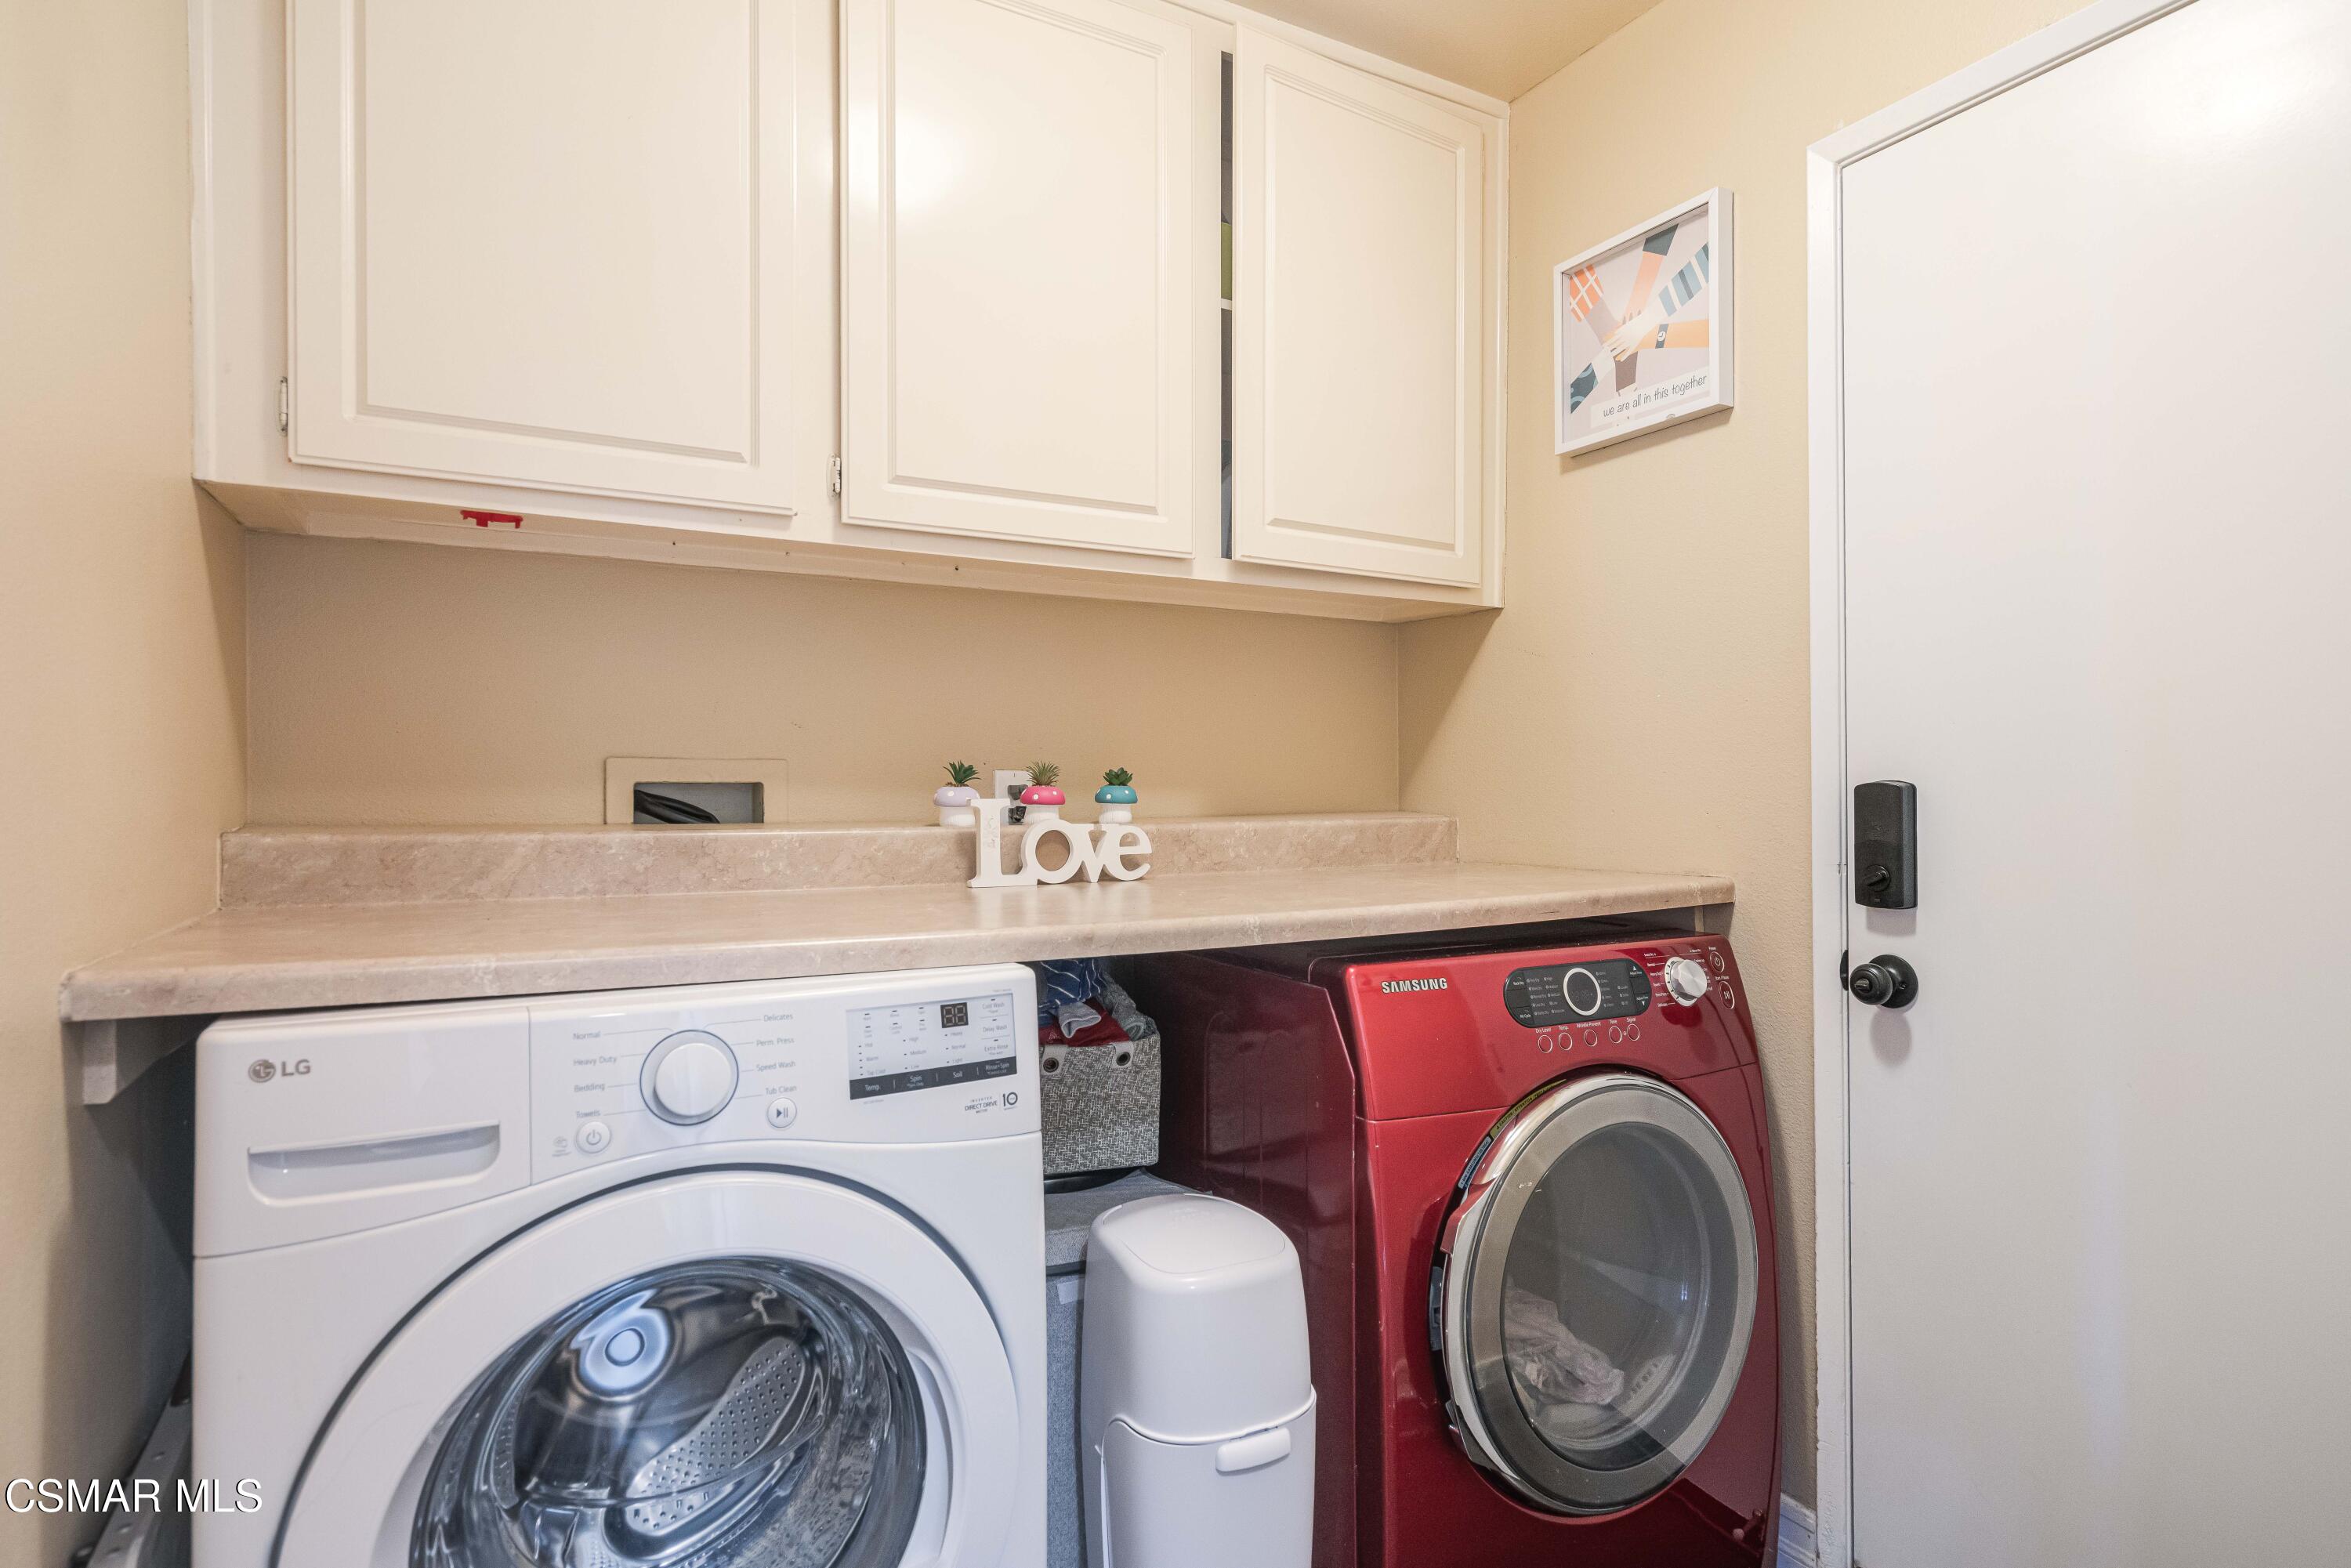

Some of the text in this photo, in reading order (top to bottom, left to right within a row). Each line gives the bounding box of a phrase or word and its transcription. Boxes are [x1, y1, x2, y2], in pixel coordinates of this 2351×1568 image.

[1603, 375, 1708, 418] we are all in this together
[965, 798, 1152, 888] Love
[1381, 977, 1447, 994] SAMSUNG
[763, 1012, 794, 1022] Delicates
[573, 1031, 601, 1041] Normal
[778, 1036, 795, 1045] Press
[573, 1055, 618, 1067] Heavy Duty
[755, 1059, 796, 1073] Speed Wash
[281, 1059, 311, 1077] LG
[574, 1082, 606, 1093] Bedding
[765, 1084, 797, 1095] Tub Clean
[964, 1102, 982, 1111] DIRECT
[983, 1099, 998, 1109] DRIVE
[1002, 1092, 1018, 1106] 10
[575, 1109, 601, 1119] Towels
